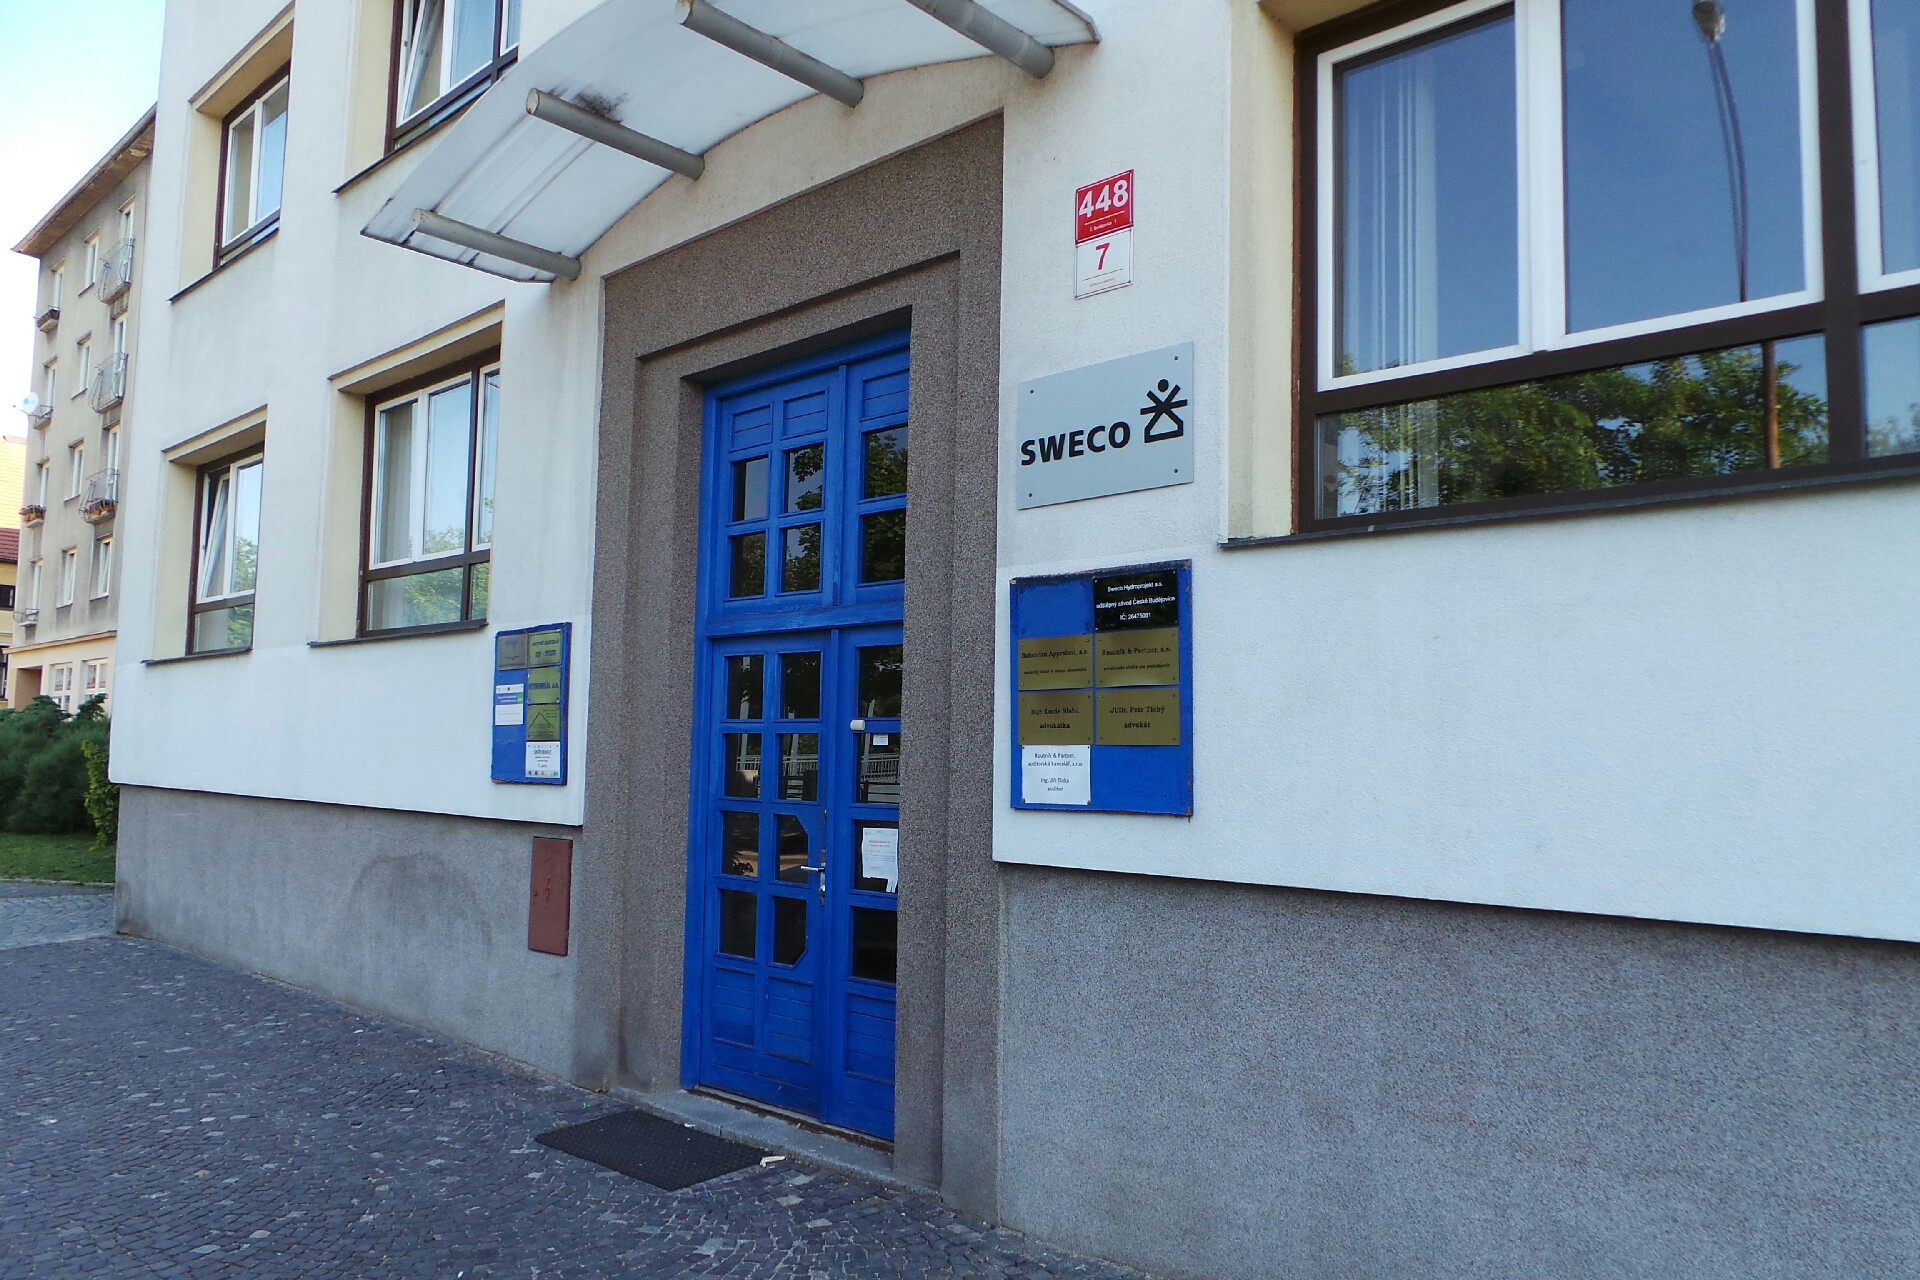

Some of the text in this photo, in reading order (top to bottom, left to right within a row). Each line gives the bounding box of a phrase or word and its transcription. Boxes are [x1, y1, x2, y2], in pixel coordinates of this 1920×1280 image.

[1079, 179, 1129, 218] 448
[1095, 242, 1111, 271] 7
[1021, 421, 1131, 466] SWECO
[1123, 582, 1154, 592] Hydroprojekt
[1096, 601, 1117, 609] odštěpný
[1132, 598, 1148, 606] České
[1148, 595, 1176, 604] Budějovice
[1109, 705, 1166, 714] JUDr. Petr Tichý
[1039, 722, 1071, 730] advokátka
[1124, 721, 1151, 730] advokát
